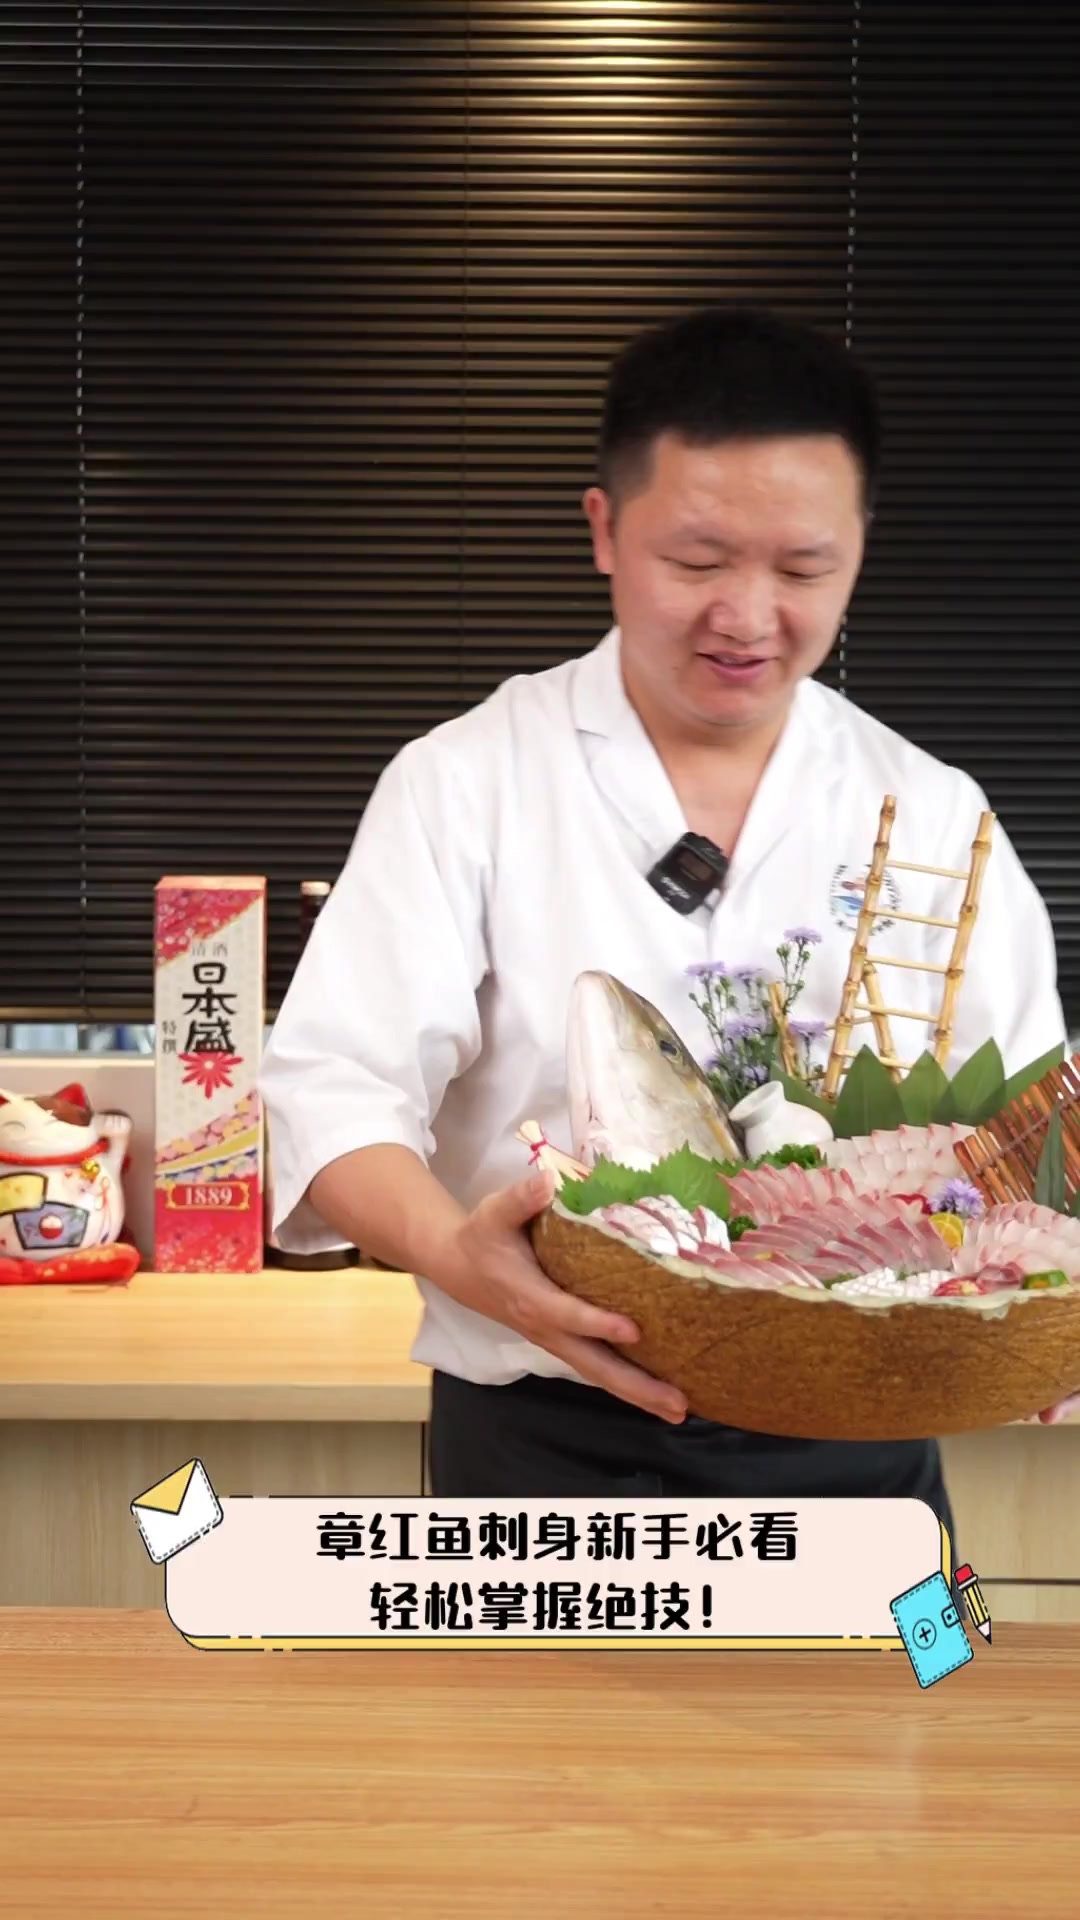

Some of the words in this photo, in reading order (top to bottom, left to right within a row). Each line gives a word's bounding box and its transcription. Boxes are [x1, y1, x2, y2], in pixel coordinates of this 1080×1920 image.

[182, 962, 238, 1055] 日本盛
[185, 1186, 233, 1206] 1889
